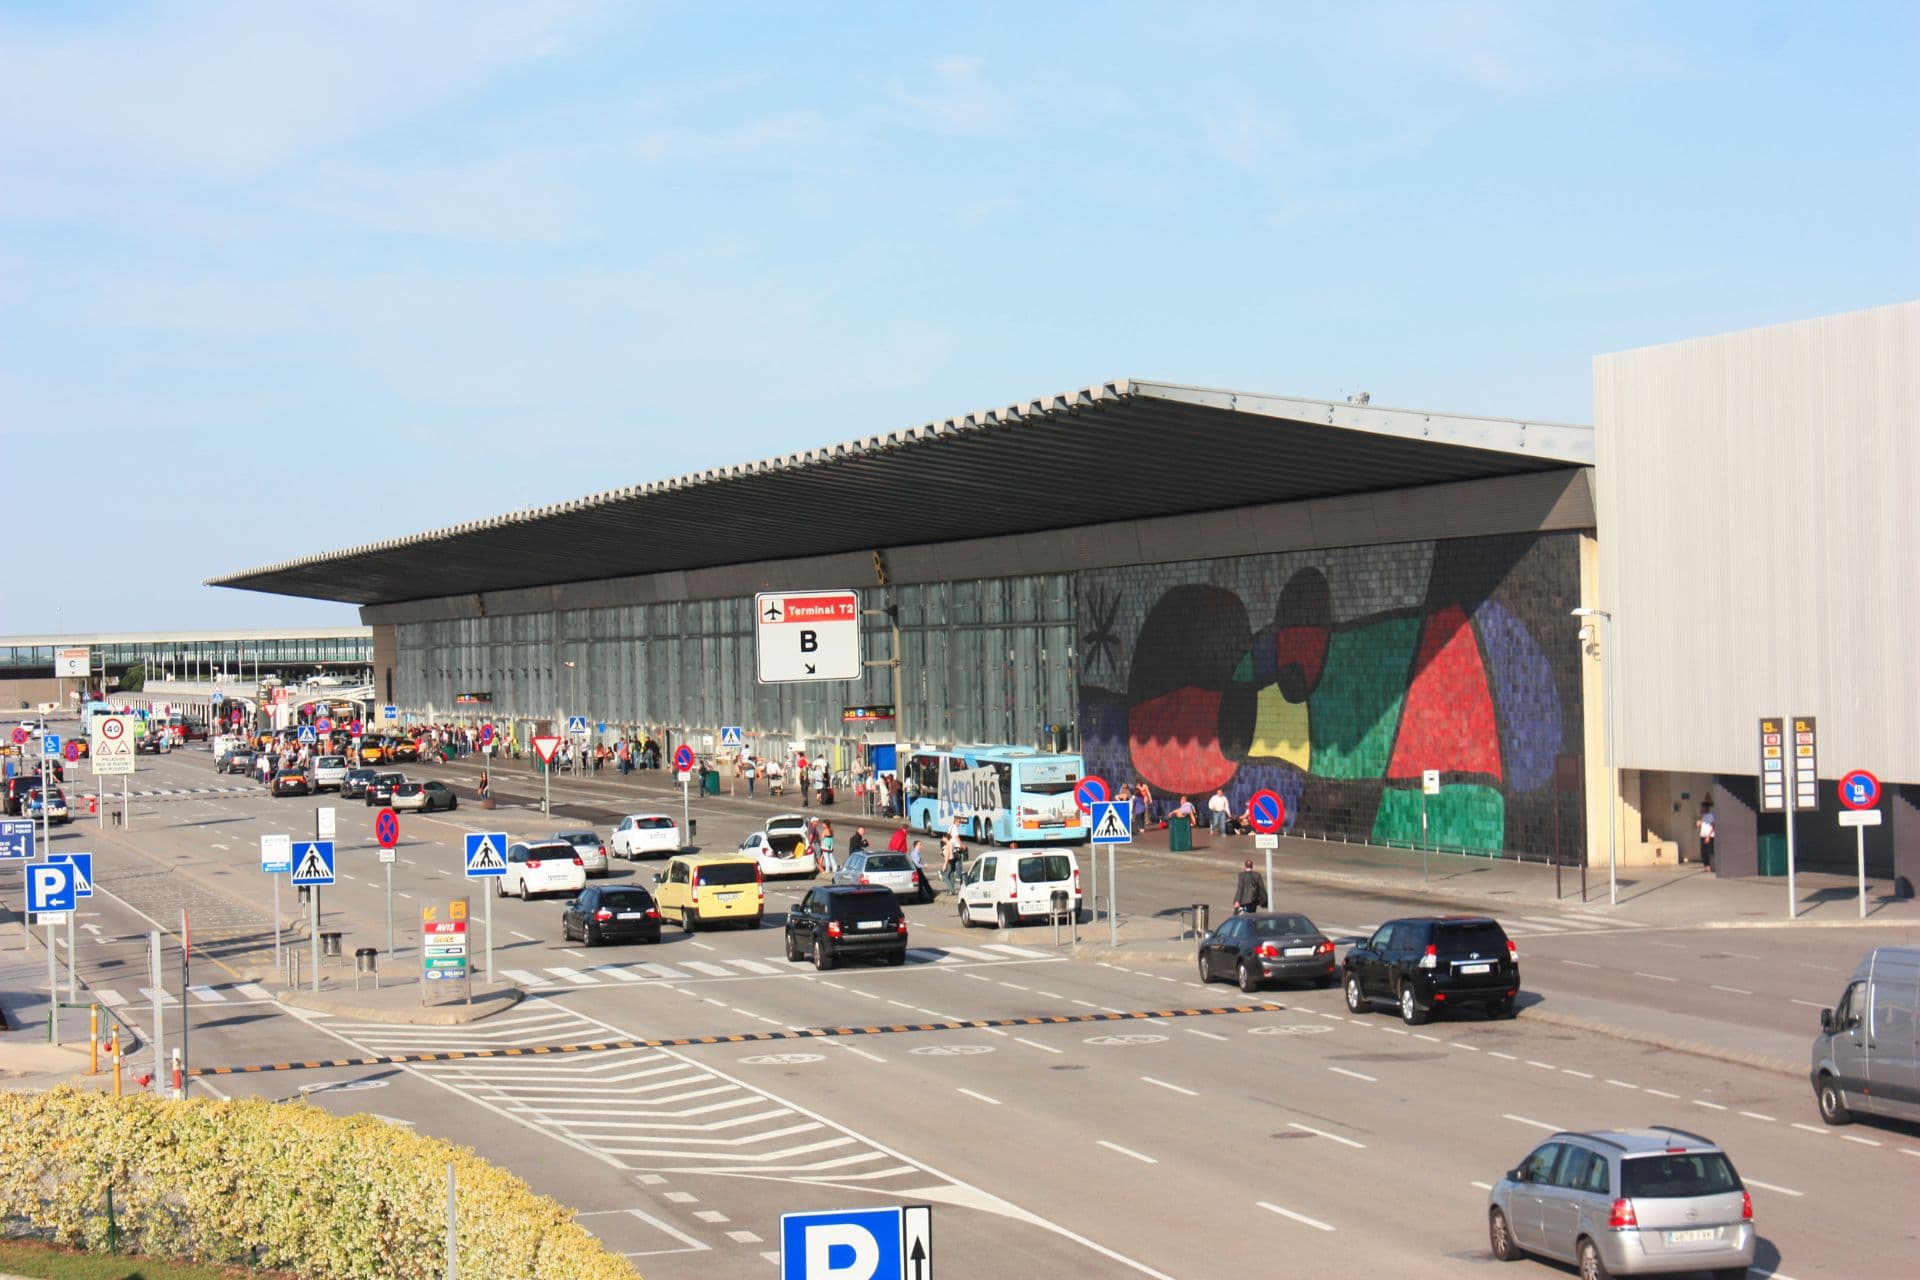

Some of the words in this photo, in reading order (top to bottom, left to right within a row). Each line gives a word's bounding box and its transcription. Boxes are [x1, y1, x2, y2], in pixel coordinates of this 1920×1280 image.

[788, 604, 835, 616] Terminal
[838, 603, 854, 614] T2
[800, 630, 818, 653] B
[940, 755, 996, 818] Aerobús
[5, 824, 12, 835] P
[35, 868, 66, 908] P
[435, 923, 456, 931] AVIS
[805, 1223, 880, 1280] P
